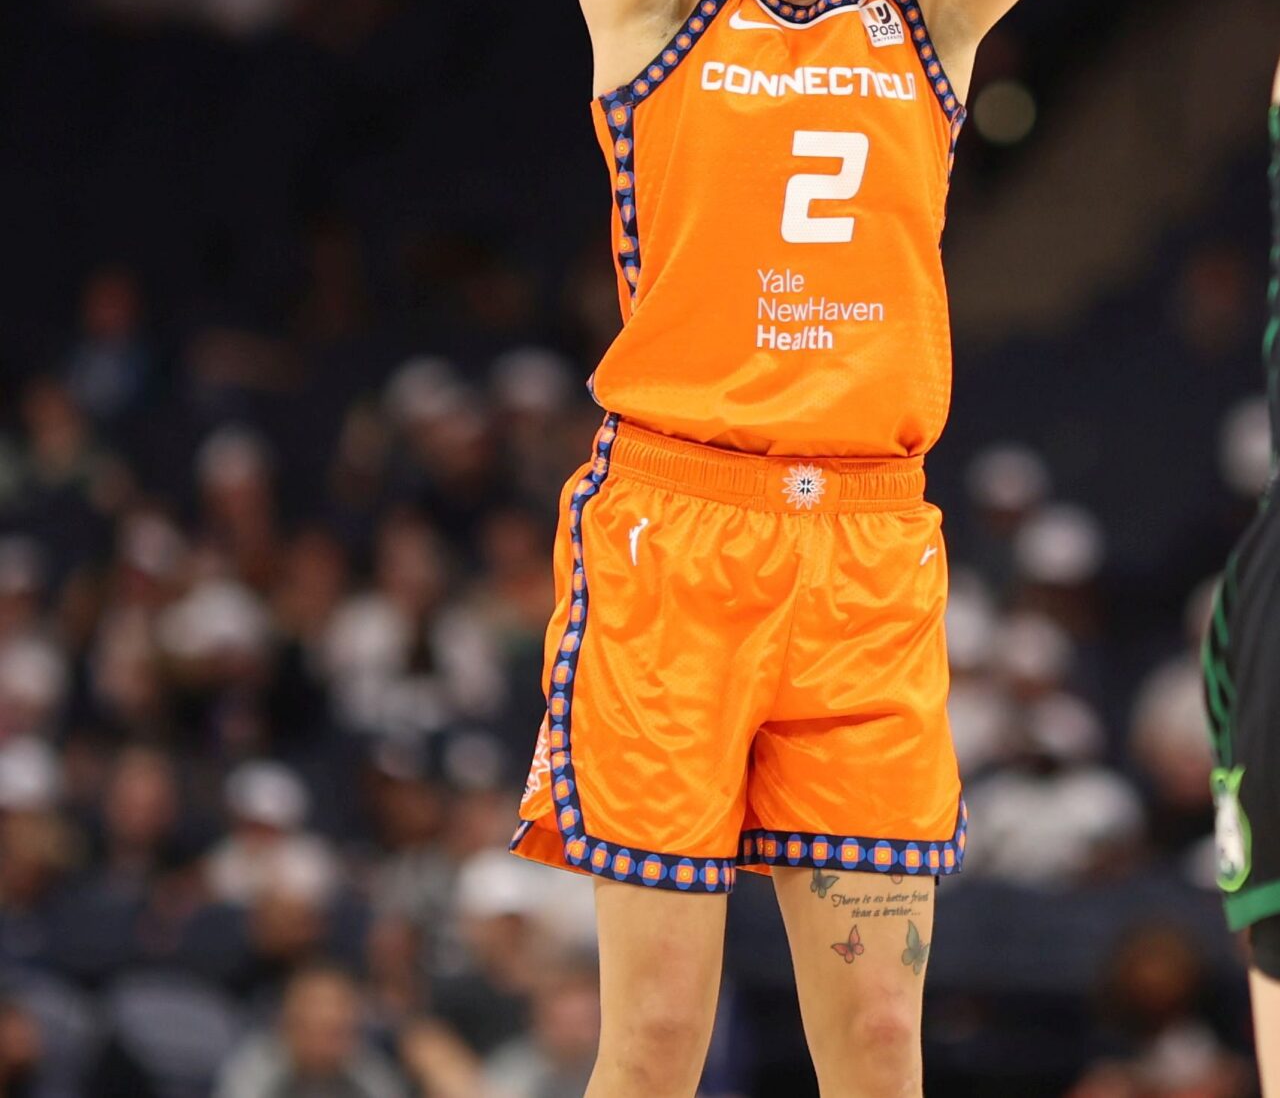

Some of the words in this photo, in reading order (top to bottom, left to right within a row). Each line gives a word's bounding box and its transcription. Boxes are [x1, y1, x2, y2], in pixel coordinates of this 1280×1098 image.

[868, 22, 901, 38] Post
[700, 61, 916, 101] CONNECTICU
[780, 130, 870, 243] 2
[757, 269, 804, 293] Yale
[757, 297, 884, 322] NewHaven
[756, 325, 833, 350] Health
[831, 893, 860, 908] There
